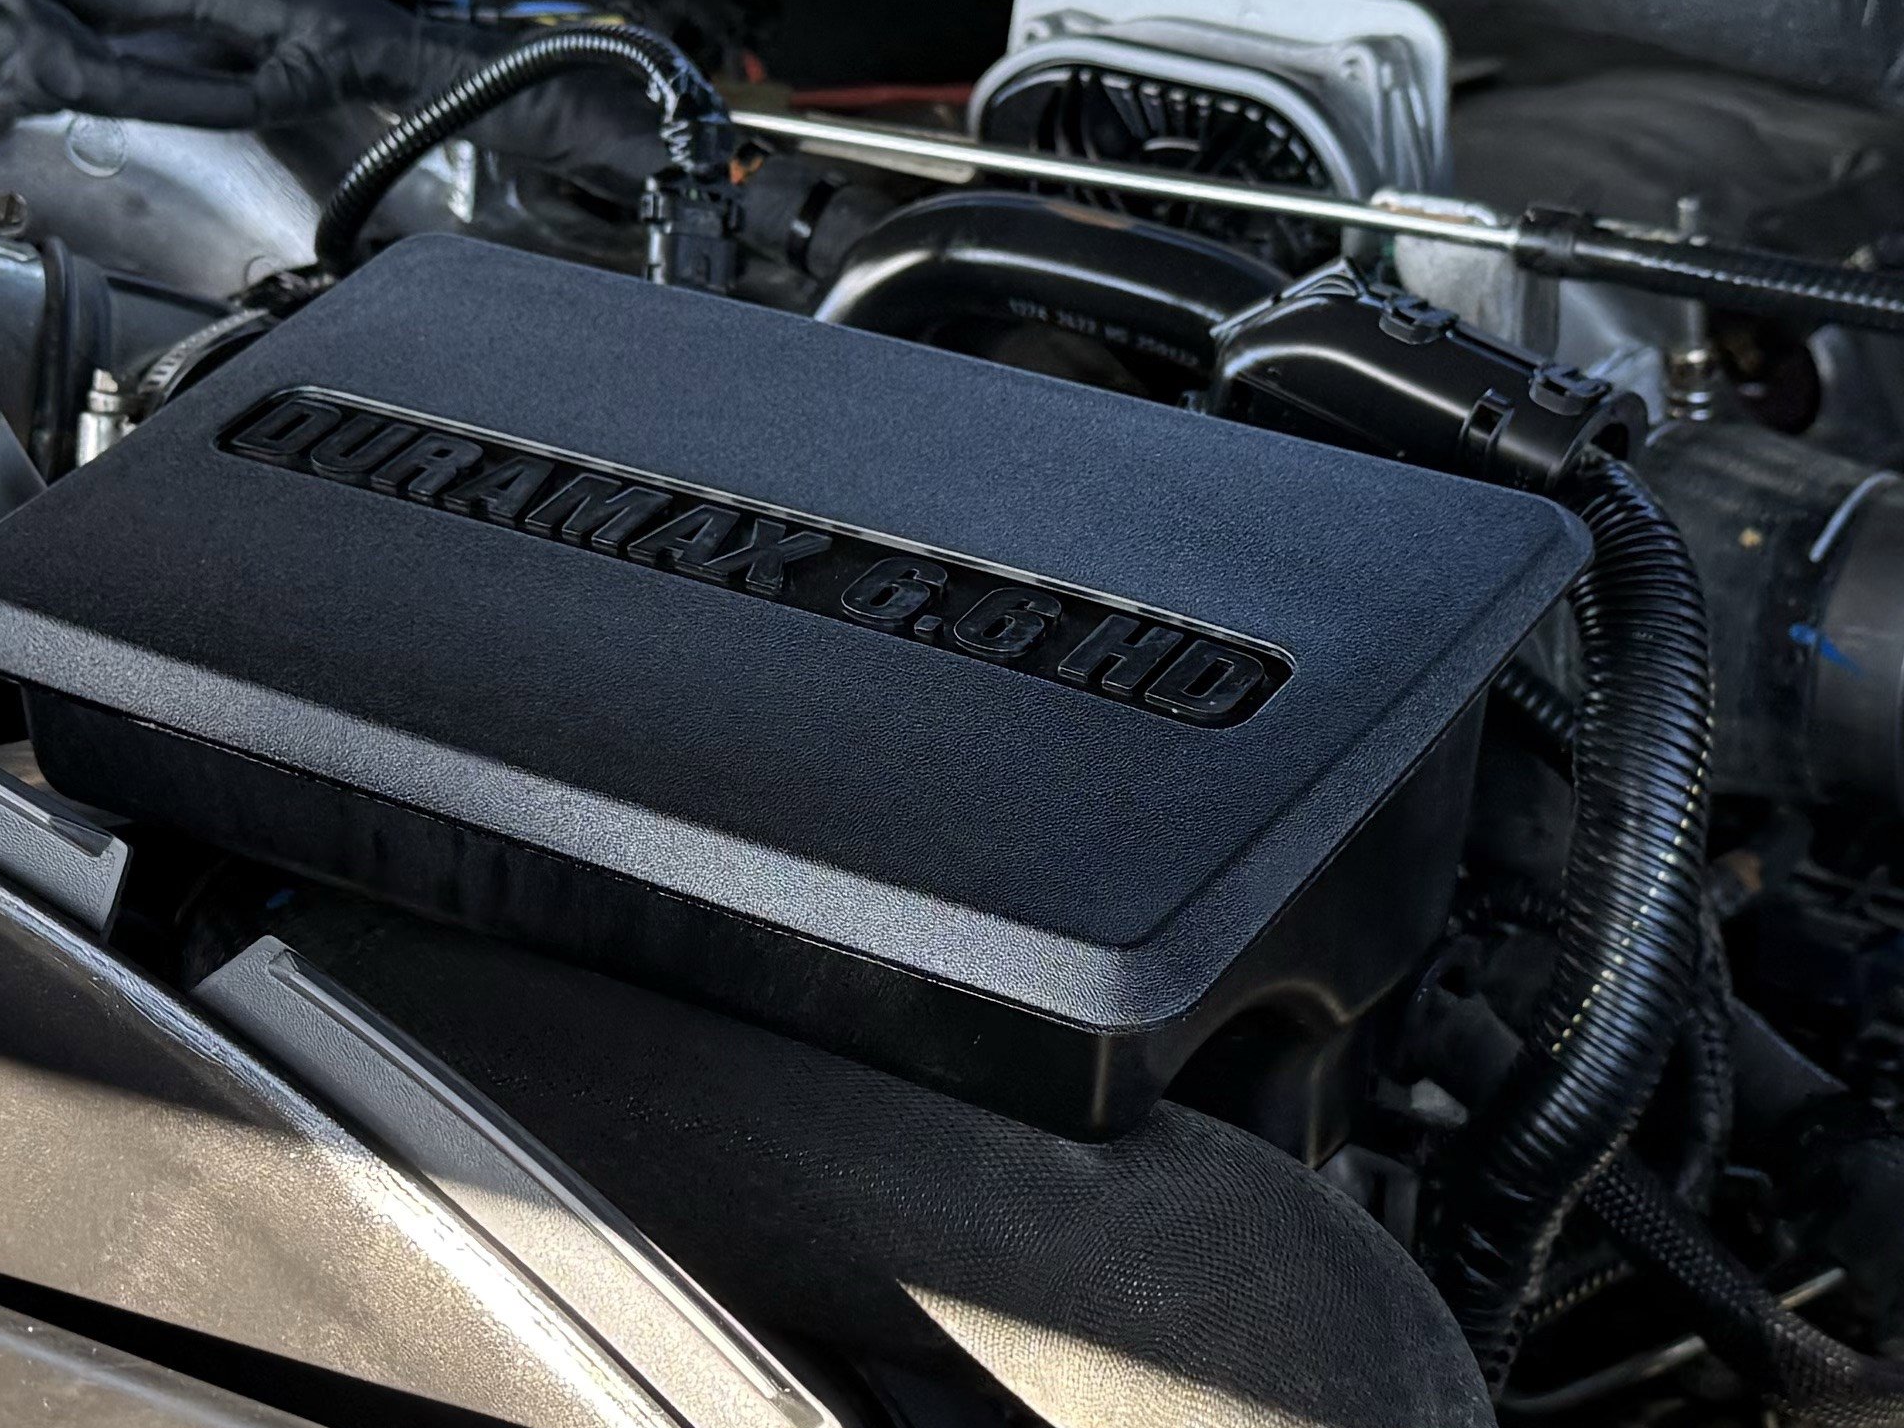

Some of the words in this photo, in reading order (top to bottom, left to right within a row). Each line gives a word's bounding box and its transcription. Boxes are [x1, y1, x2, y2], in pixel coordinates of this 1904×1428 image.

[230, 398, 832, 594] DURAMAX
[841, 556, 1063, 654] 6.6
[1058, 613, 1264, 715] HD
